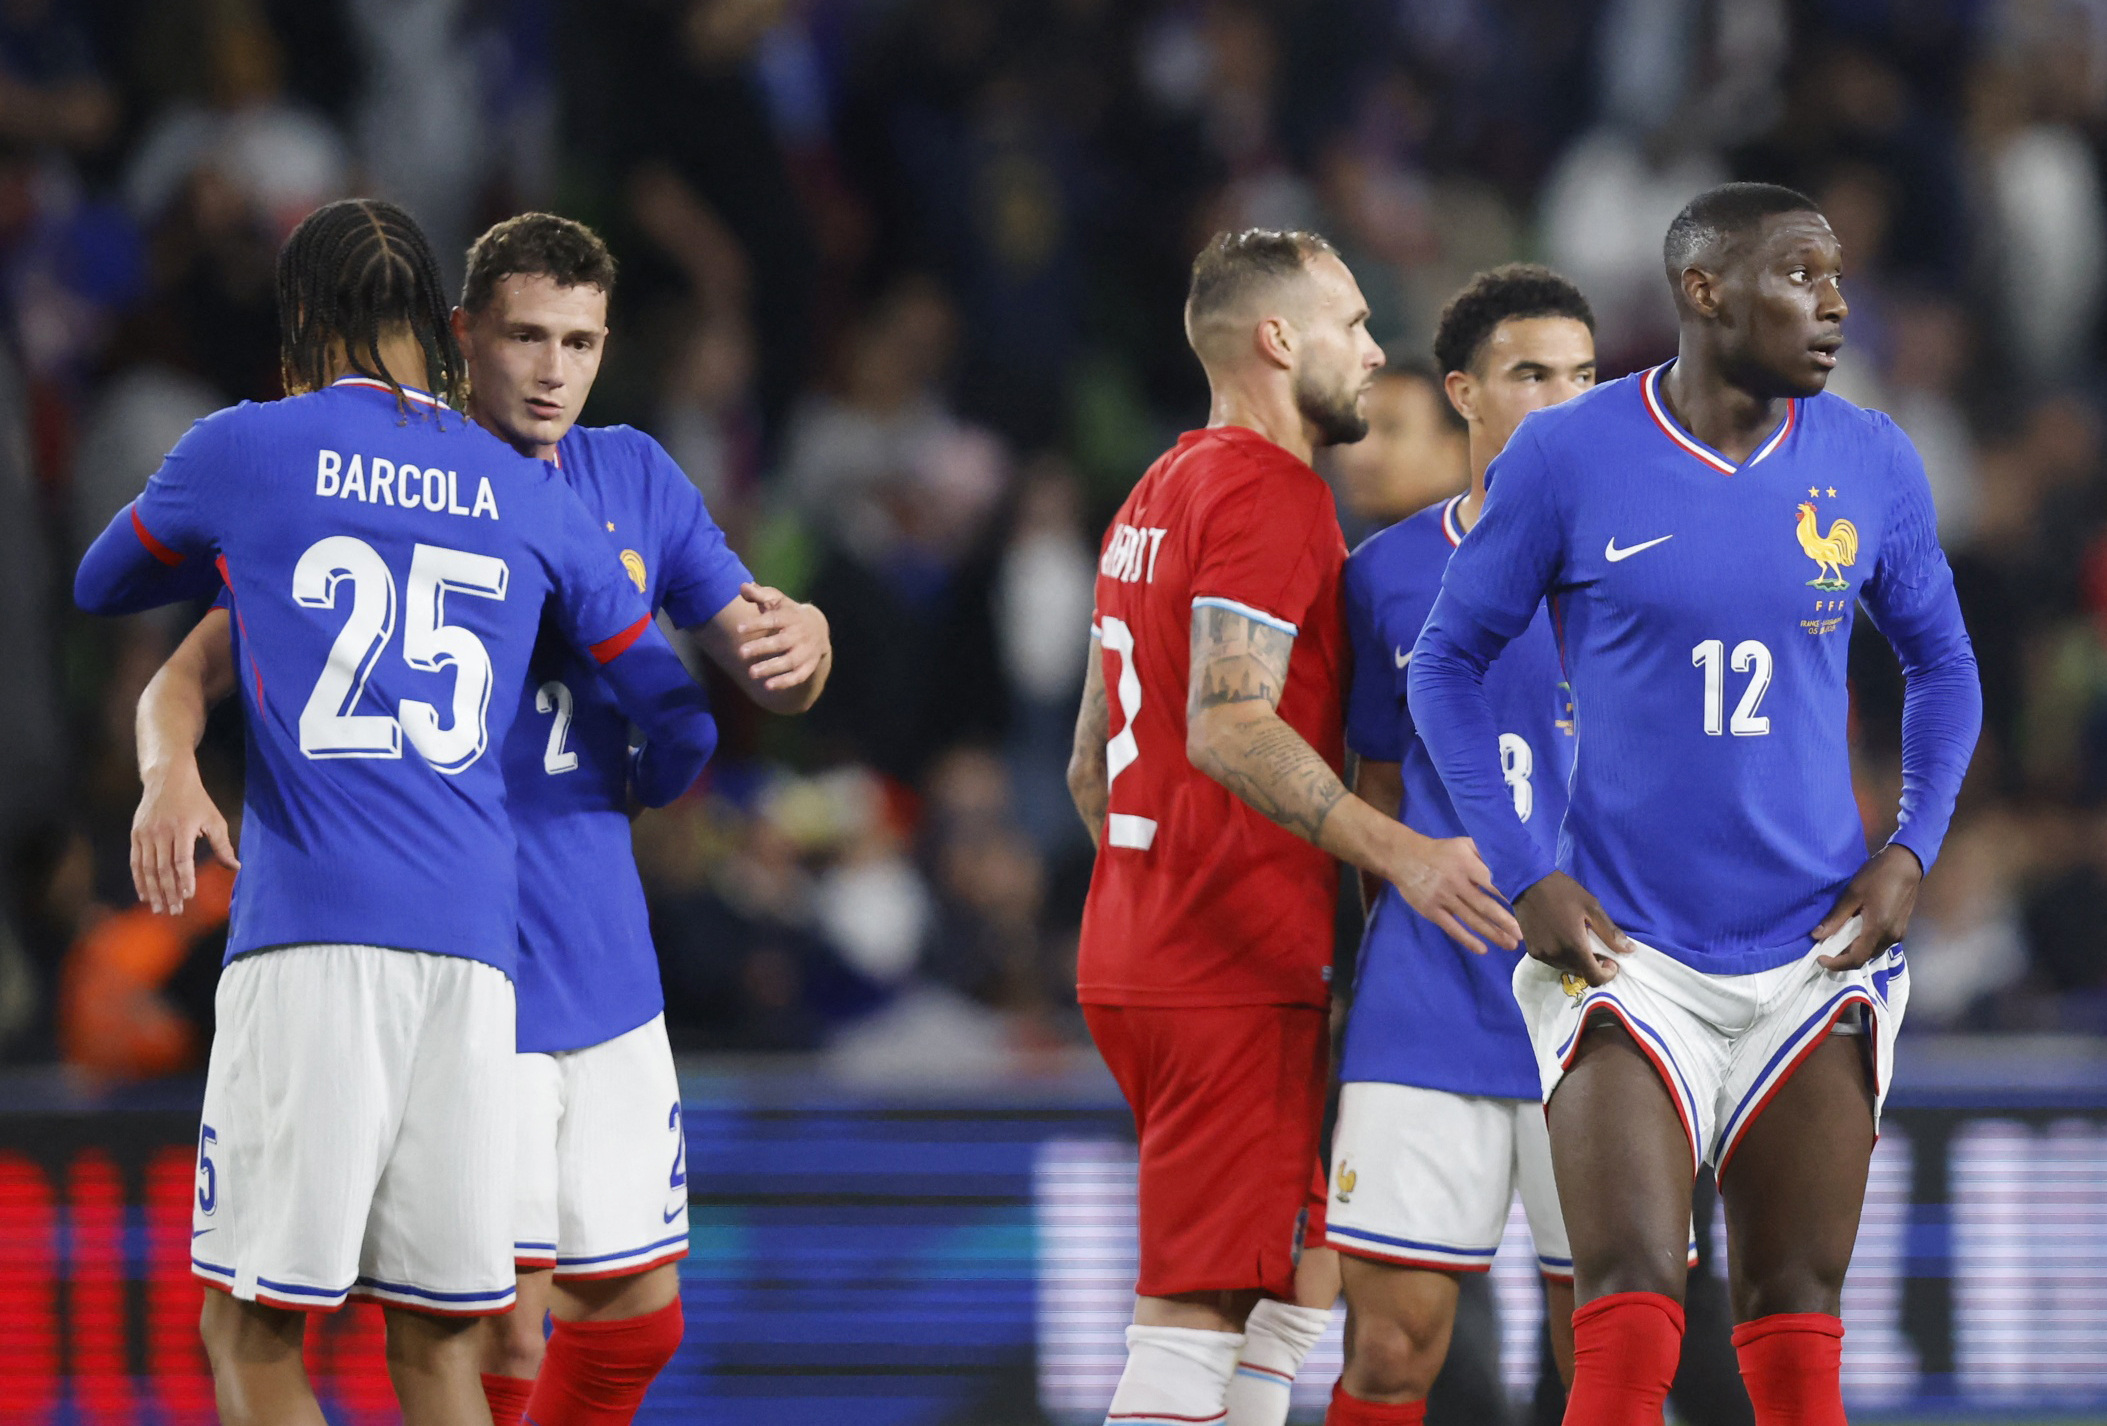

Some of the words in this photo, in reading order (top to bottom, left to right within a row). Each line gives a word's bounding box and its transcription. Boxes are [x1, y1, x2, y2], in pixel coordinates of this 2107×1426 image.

[316, 449, 500, 520] BARCOLA
[292, 535, 510, 775] 25
[1692, 639, 1772, 736] 12
[535, 680, 578, 774] 2
[1498, 733, 1533, 823] 8
[198, 1123, 218, 1216] 5
[668, 1101, 687, 1191] 2
